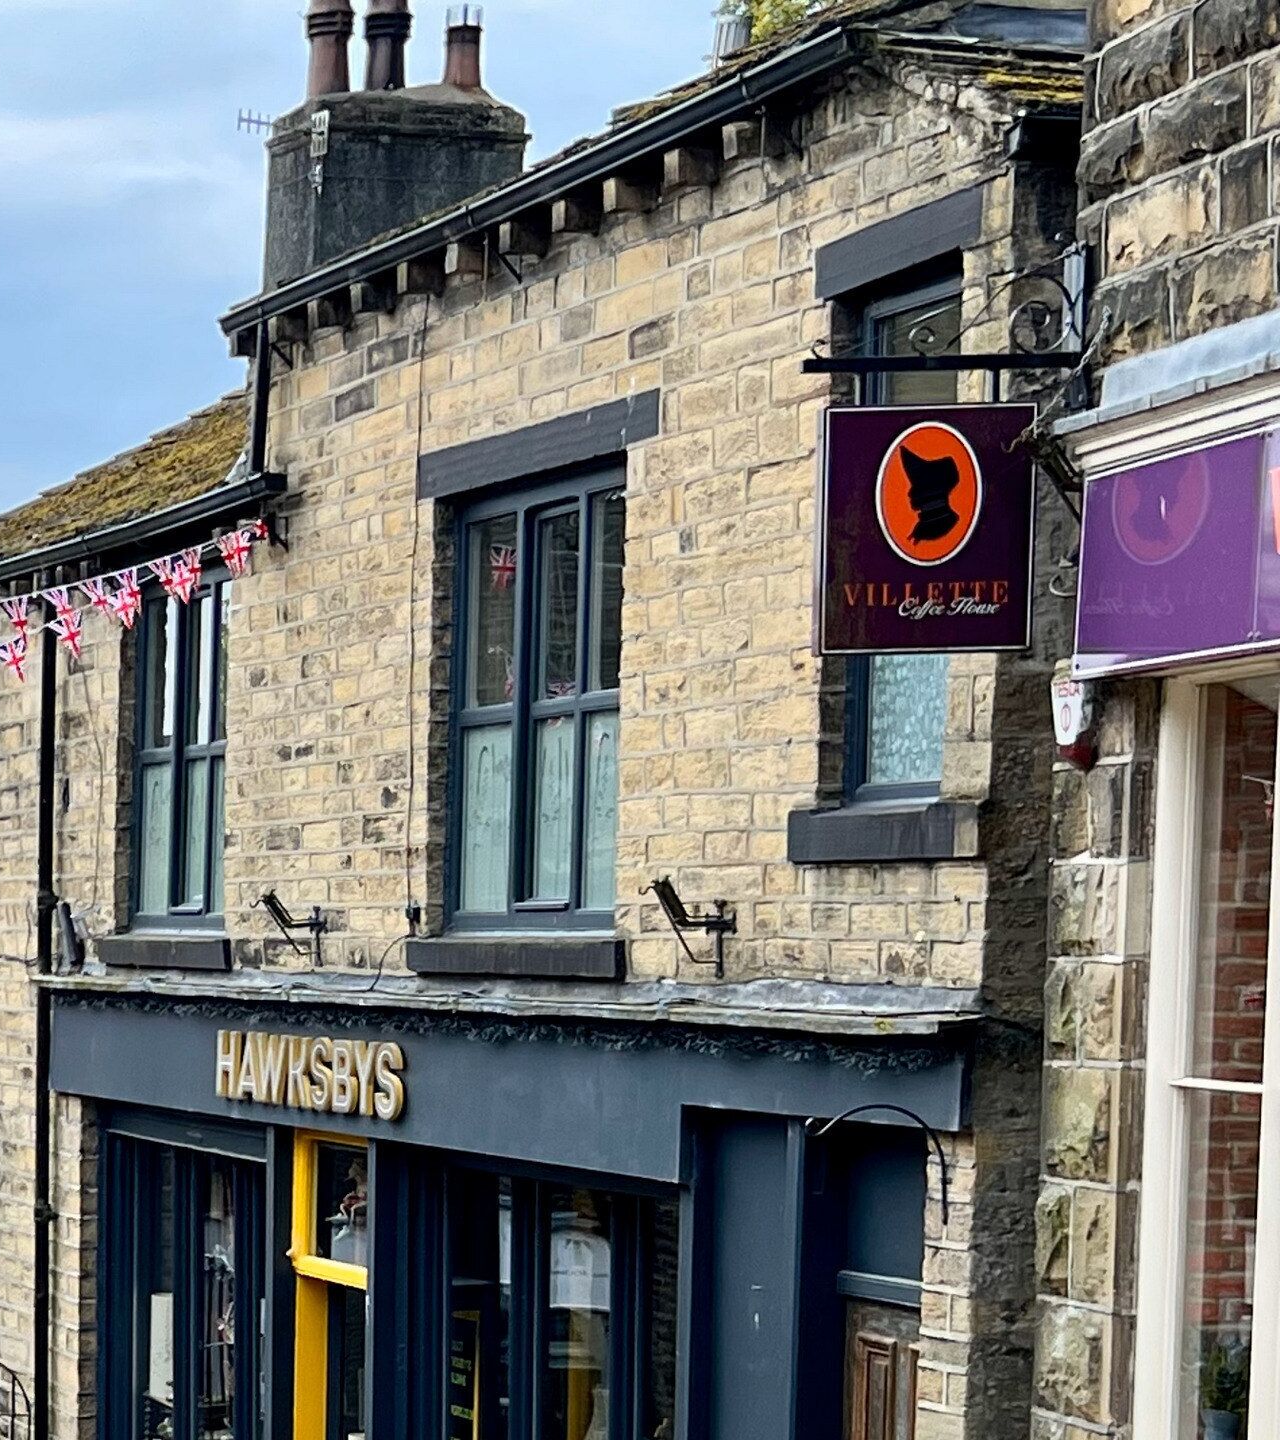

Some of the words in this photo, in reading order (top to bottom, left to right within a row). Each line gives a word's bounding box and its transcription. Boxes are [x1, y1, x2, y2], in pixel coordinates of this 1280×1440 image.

[843, 580, 1010, 607] VILLETTE
[898, 596, 946, 620] Coffee
[946, 595, 1001, 616] House
[215, 1028, 404, 1121] HAWKSBYS
